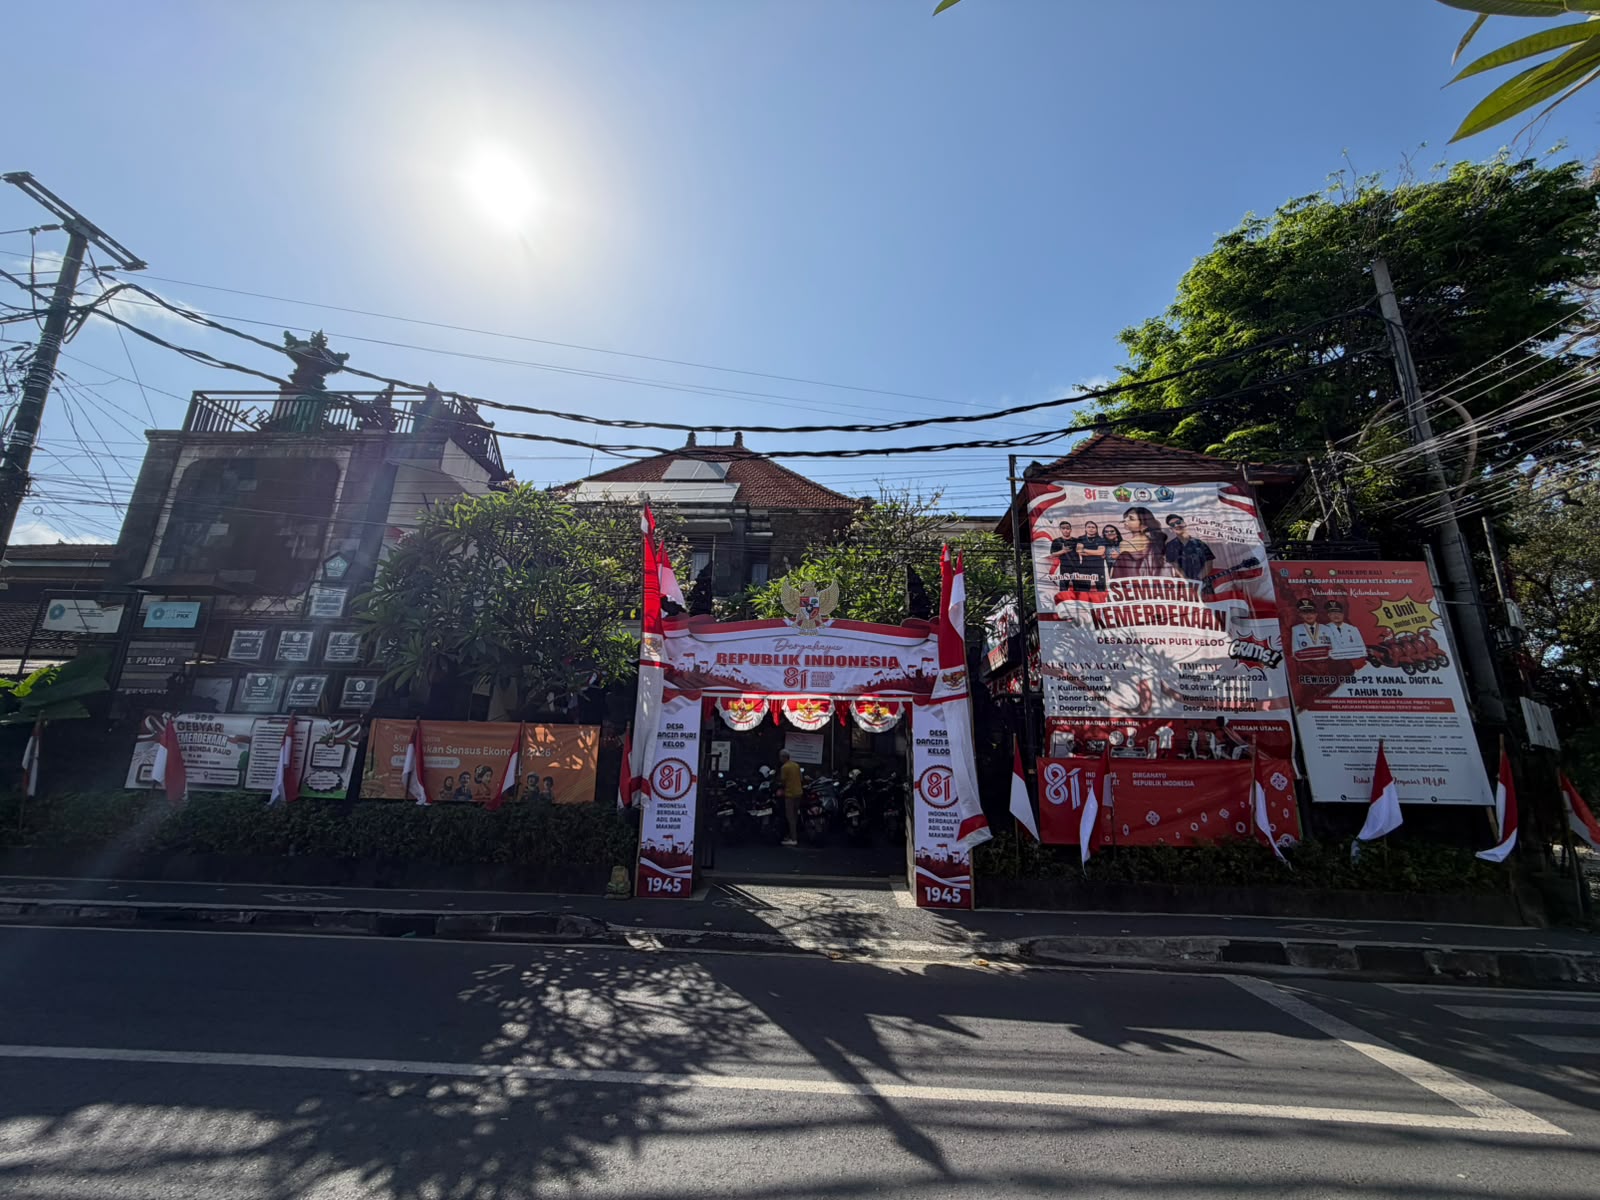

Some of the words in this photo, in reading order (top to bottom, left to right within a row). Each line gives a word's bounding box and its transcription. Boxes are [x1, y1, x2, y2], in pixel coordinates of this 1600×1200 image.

[1084, 488, 1096, 500] 81
[1110, 580, 1200, 602] SEMARAK
[1091, 604, 1227, 632] KEMERDEKAAN
[1383, 606, 1393, 619] 8
[1393, 601, 1418, 617] Unit
[1097, 637, 1123, 645] DESA
[1126, 637, 1166, 645] DANGIN
[1169, 638, 1192, 646] PURI
[1195, 638, 1225, 647] KELOD
[716, 652, 800, 667] REPUBLIK
[804, 654, 902, 669] INDONESIA
[1229, 640, 1282, 668] GRATIS!
[1095, 662, 1126, 670] ACARA
[784, 667, 810, 690] 81
[1299, 676, 1337, 684] REWARD
[1340, 676, 1374, 684] PBB-P2
[1376, 676, 1407, 684] KANAL
[1409, 676, 1443, 685] DIGITAL
[177, 722, 223, 732] GEBYAR
[176, 732, 228, 746] EMERDEKAAN
[213, 747, 231, 755] PAUD
[446, 745, 480, 755] Sensus
[659, 765, 684, 794] 81
[928, 772, 951, 802] 81
[1044, 763, 1082, 810] 81
[647, 877, 681, 892] 1945
[925, 886, 961, 903] 1945
